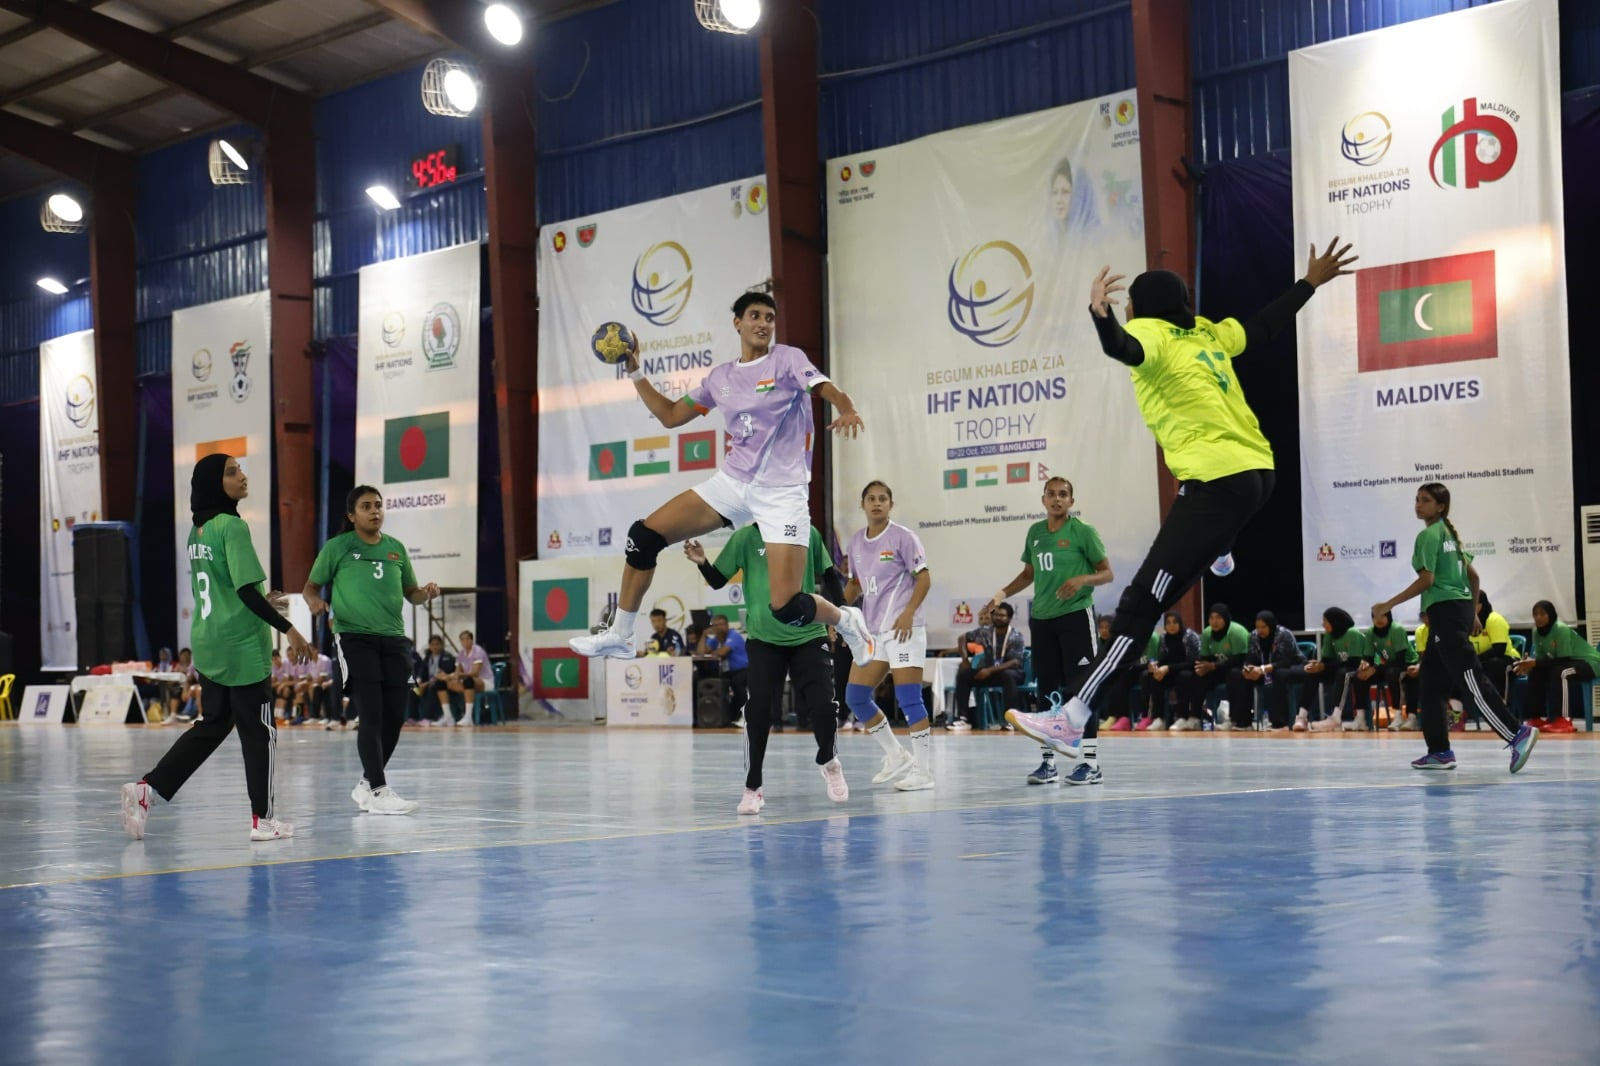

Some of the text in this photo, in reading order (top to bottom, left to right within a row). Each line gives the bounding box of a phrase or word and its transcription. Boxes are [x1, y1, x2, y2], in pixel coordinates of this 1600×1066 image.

[1480, 102, 1521, 122] MALDIVES
[1328, 167, 1410, 188] BEGUM KHALEDA ZIA
[1328, 178, 1411, 203] IHF NATIONS
[1345, 198, 1393, 215] TROPHY
[650, 335, 693, 350] KHALEDA
[697, 331, 713, 344] ZIA
[616, 349, 713, 380] IH NATIONS
[926, 354, 1065, 386] BEGUM KHALEDA ZIA
[927, 376, 1067, 415] IHF NATIONS
[1376, 379, 1480, 408] MALDIVES
[739, 412, 754, 437] 3
[954, 412, 1036, 442] TROPHY
[999, 439, 1046, 453] BANGLADESH
[1414, 463, 1443, 472] Venue:
[1332, 480, 1362, 489] Shaheed
[1363, 478, 1390, 487] Captain
[1397, 476, 1423, 484] Monsur
[1435, 472, 1465, 481] National
[1467, 469, 1500, 479] Handball
[1502, 467, 1534, 477] Stadium
[385, 493, 446, 510] BANGLADESH
[984, 504, 1008, 513] Venue:
[918, 520, 941, 528] Shaheed
[942, 519, 964, 528] Captain
[1001, 514, 1026, 522] National
[371, 561, 384, 579] 3
[1036, 551, 1054, 571] 10
[864, 575, 878, 596] 14
